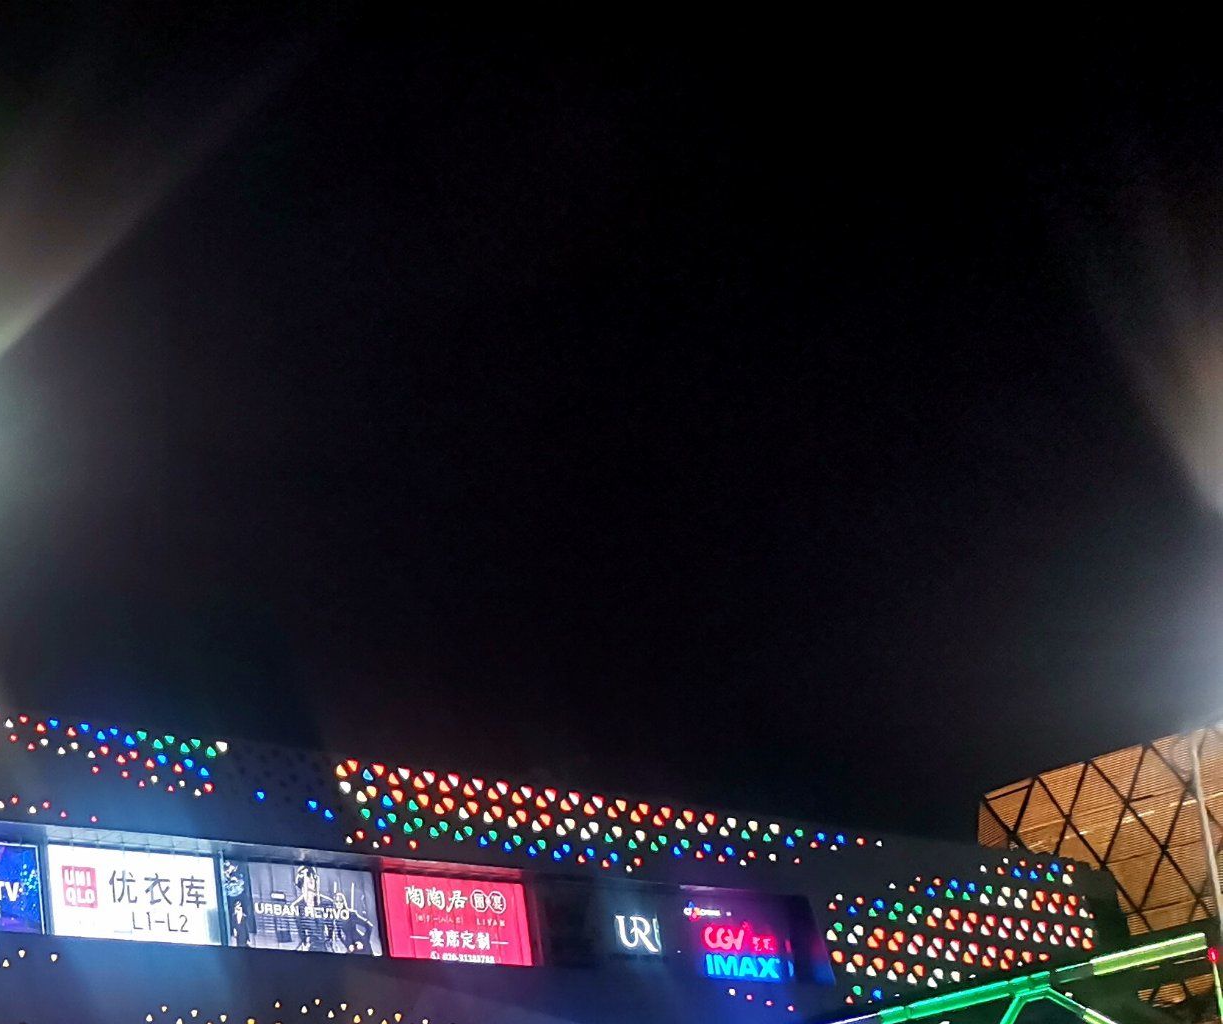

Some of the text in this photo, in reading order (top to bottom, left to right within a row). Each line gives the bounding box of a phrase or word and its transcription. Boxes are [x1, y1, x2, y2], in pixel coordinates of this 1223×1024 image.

[64, 869, 92, 887] UNI
[109, 870, 207, 908] 优衣库
[65, 886, 95, 905] QLO
[404, 885, 468, 912] 陶陶居
[255, 903, 300, 917] URBAN
[132, 911, 189, 933] L1-L2
[615, 915, 660, 953] UR
[706, 954, 780, 979] IMAX
